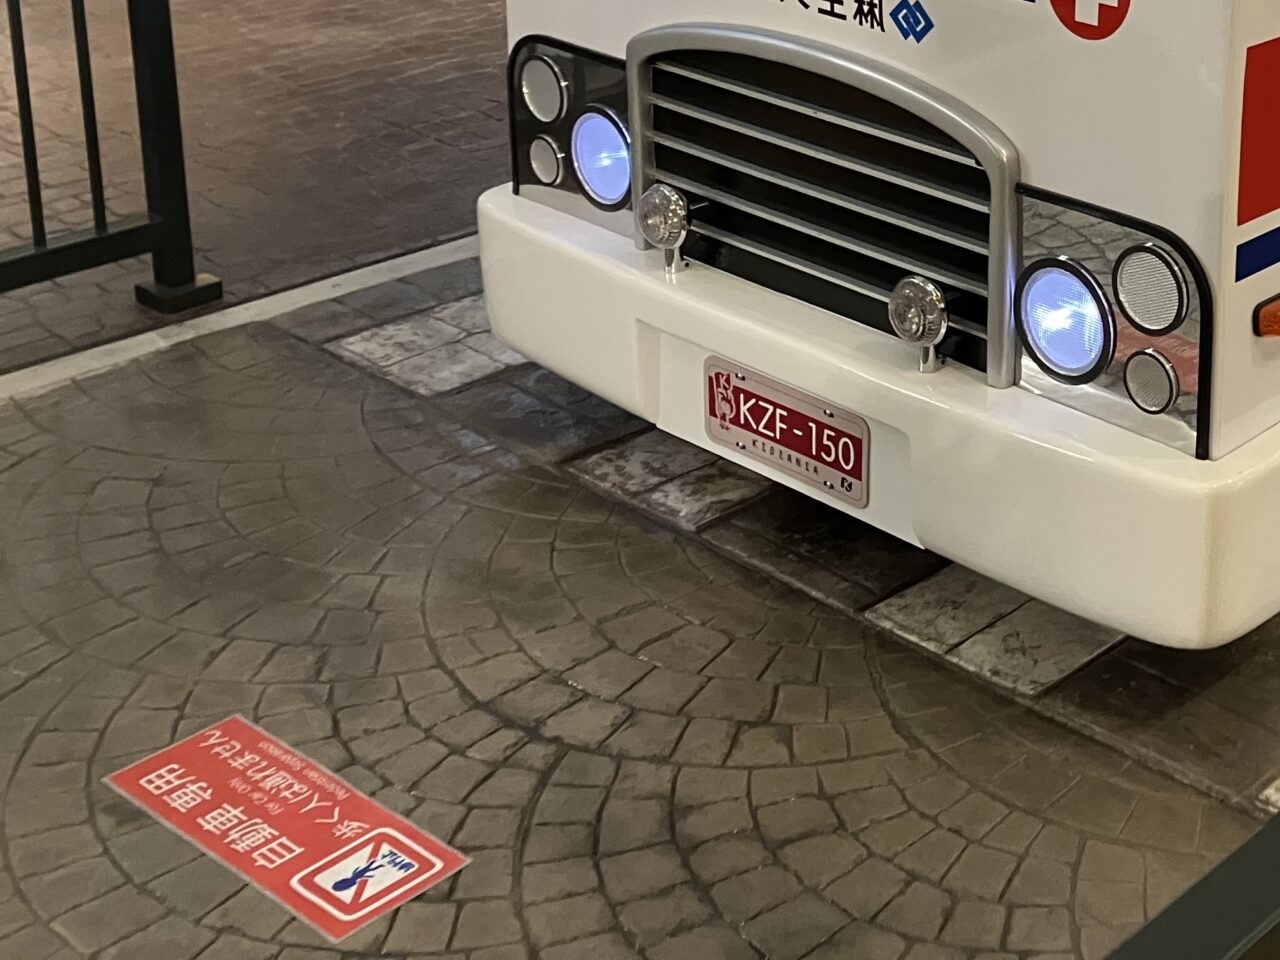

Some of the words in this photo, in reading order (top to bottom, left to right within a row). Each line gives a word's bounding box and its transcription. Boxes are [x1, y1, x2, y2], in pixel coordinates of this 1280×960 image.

[739, 393, 855, 471] KZF-150
[752, 439, 820, 476] KIDZANIA
[196, 729, 371, 840] 歩く人は通れません
